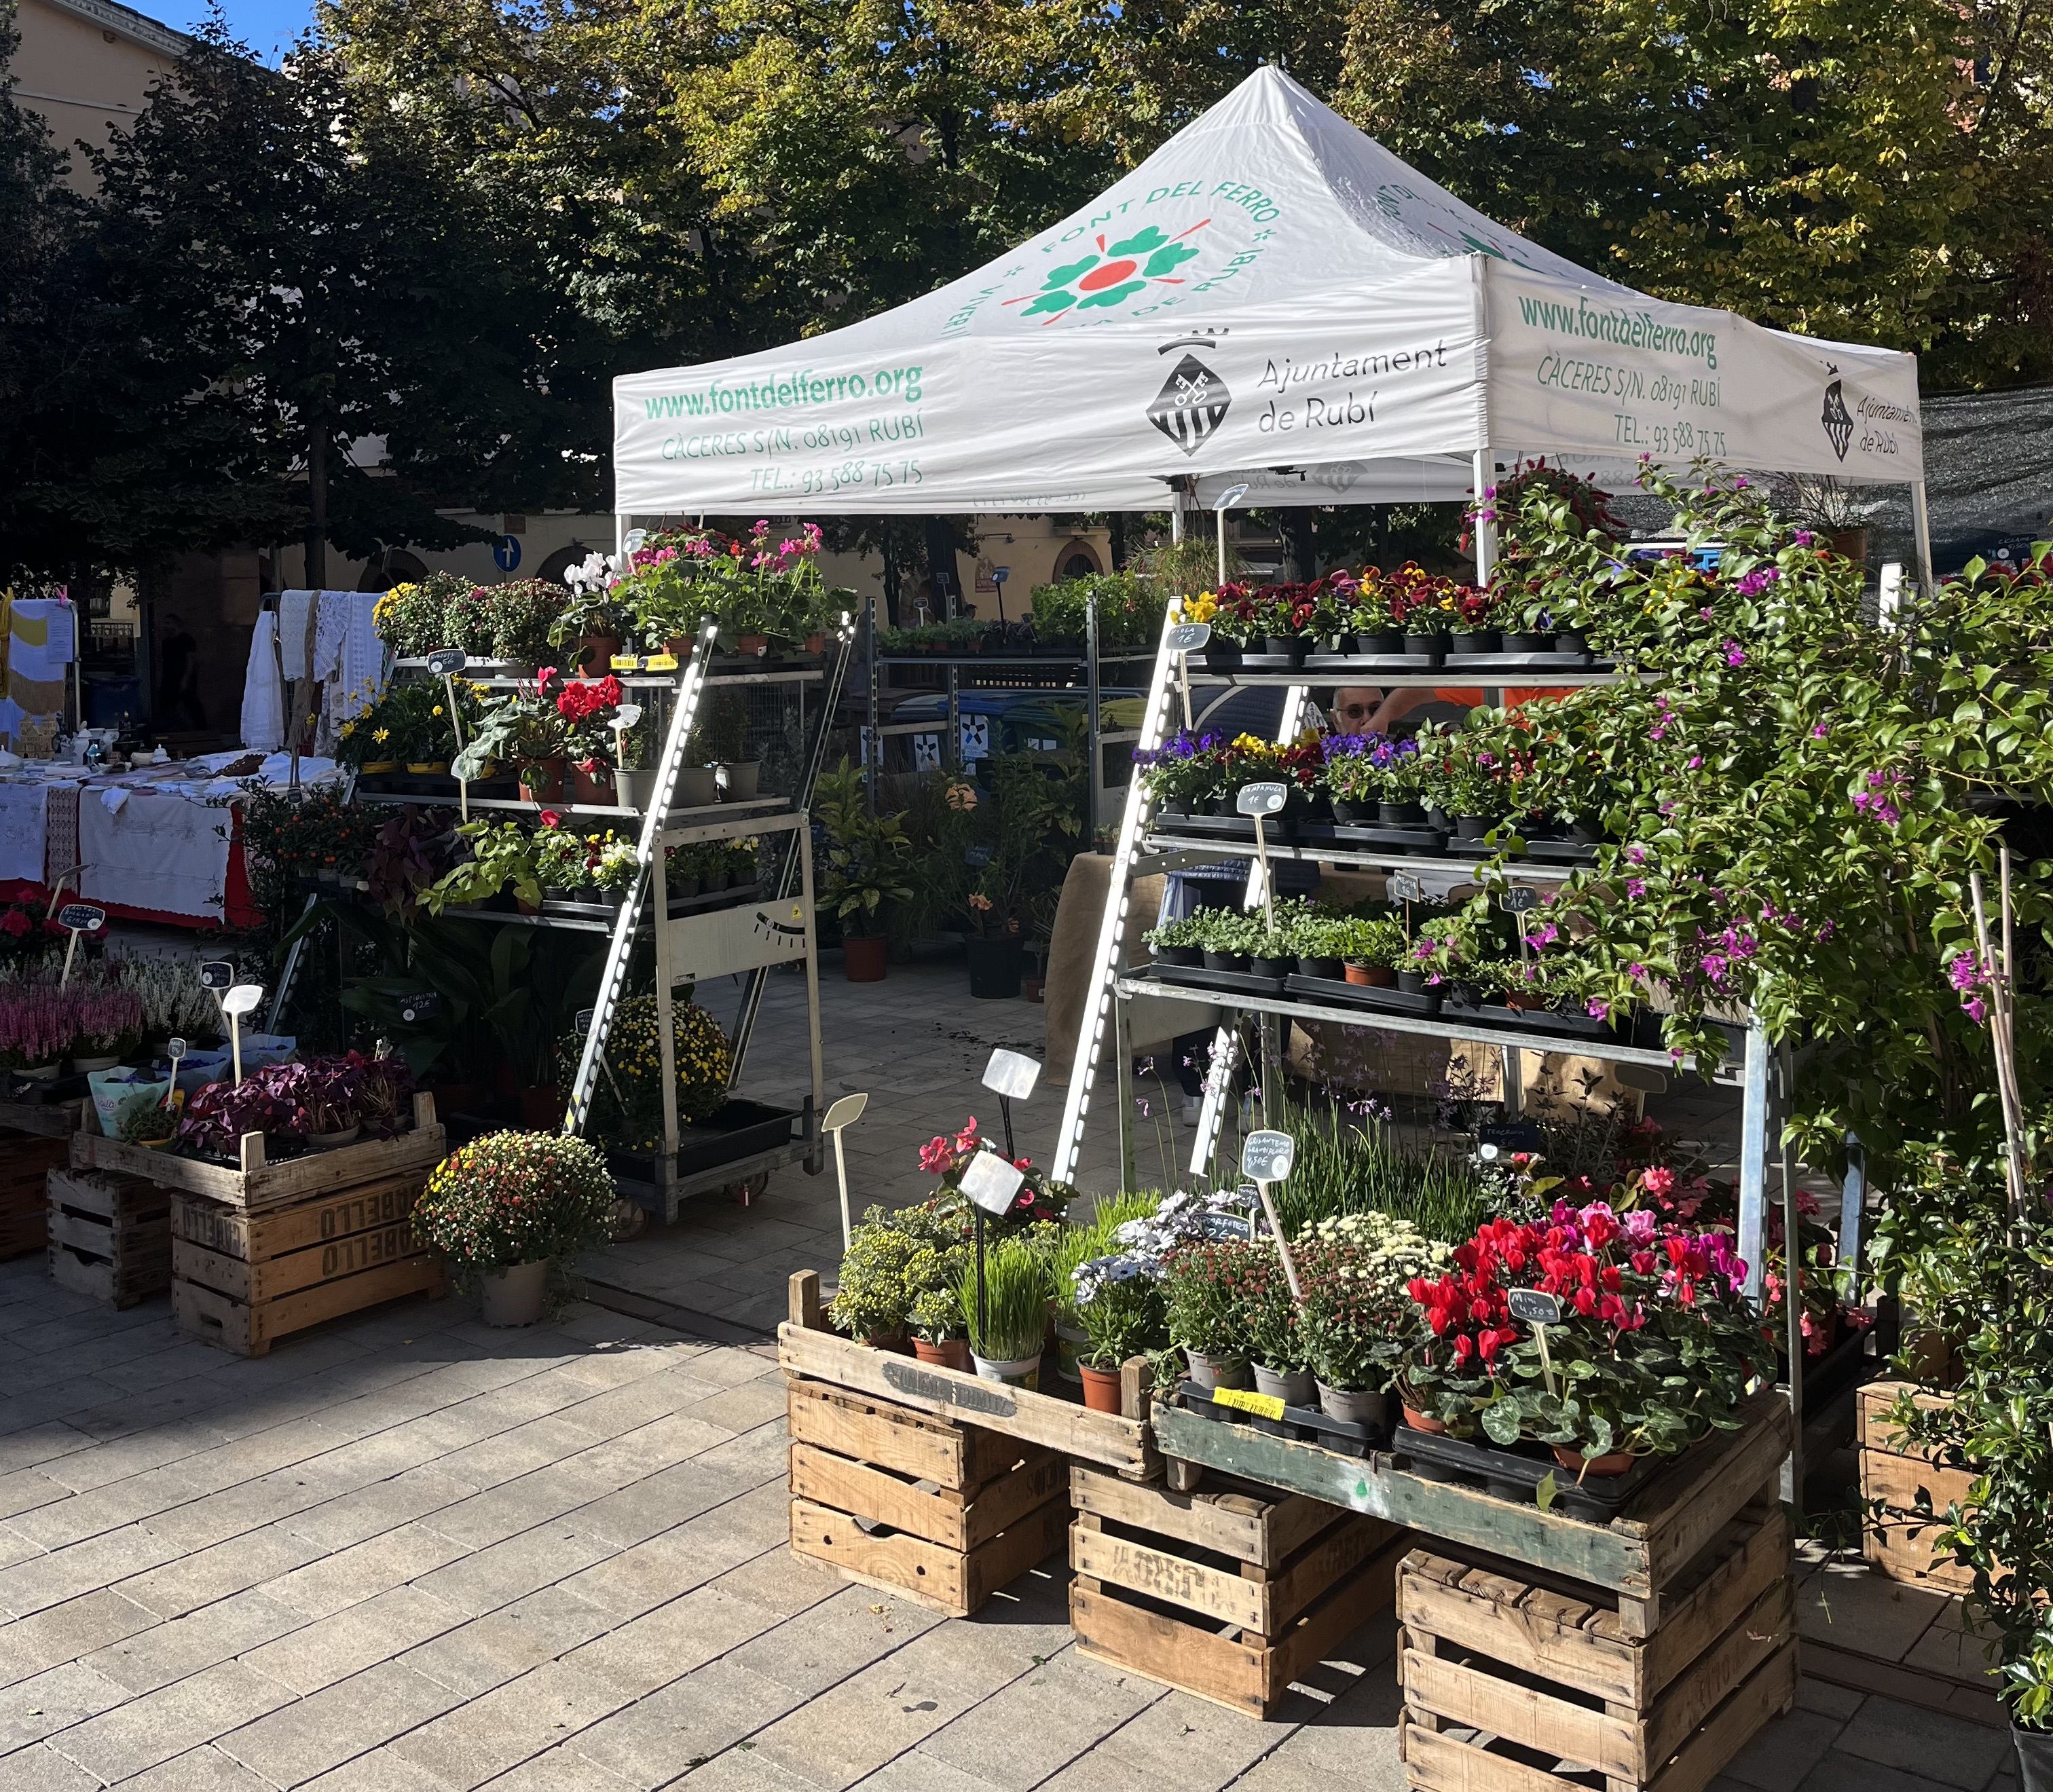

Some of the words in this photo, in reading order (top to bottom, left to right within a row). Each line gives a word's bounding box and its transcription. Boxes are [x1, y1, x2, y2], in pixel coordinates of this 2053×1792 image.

[1041, 198, 1136, 254] FONT
[1146, 180, 1204, 203] DEL
[1210, 181, 1280, 223] FERRO
[1132, 297, 1187, 316] DE
[1518, 296, 1718, 370] www.fontdelferro.org
[1257, 339, 1447, 394] Ajuntament
[1537, 350, 1612, 394] CÀCERES
[1614, 369, 1646, 406] S/N.
[1650, 375, 1686, 410] 08191
[1690, 376, 1721, 407] RUBÍ
[644, 366, 923, 419] www.fontdelferro.org
[1259, 400, 1295, 432] de
[1306, 390, 1378, 428] Rubí
[662, 432, 747, 460] CÀCERES
[754, 428, 798, 460] S/N.
[803, 424, 862, 451] 08191
[868, 407, 924, 443] RUBÍ
[1654, 426, 1669, 453] 93
[1673, 422, 1694, 455] 588
[1697, 430, 1710, 455] 75
[1714, 431, 1727, 457] 75
[1860, 427, 1874, 451] de
[802, 469, 823, 493] 93
[832, 460, 865, 491] 588
[871, 462, 893, 487] 75
[899, 460, 923, 485] 75
[1177, 633, 1195, 643] 1€
[1247, 795, 1260, 804] 1€
[1401, 885, 1411, 896] 1€
[1511, 897, 1524, 909] 1€
[412, 998, 430, 1011] 12€
[1246, 1155, 1269, 1170] 4,50€
[1208, 1227, 1229, 1239] 2€
